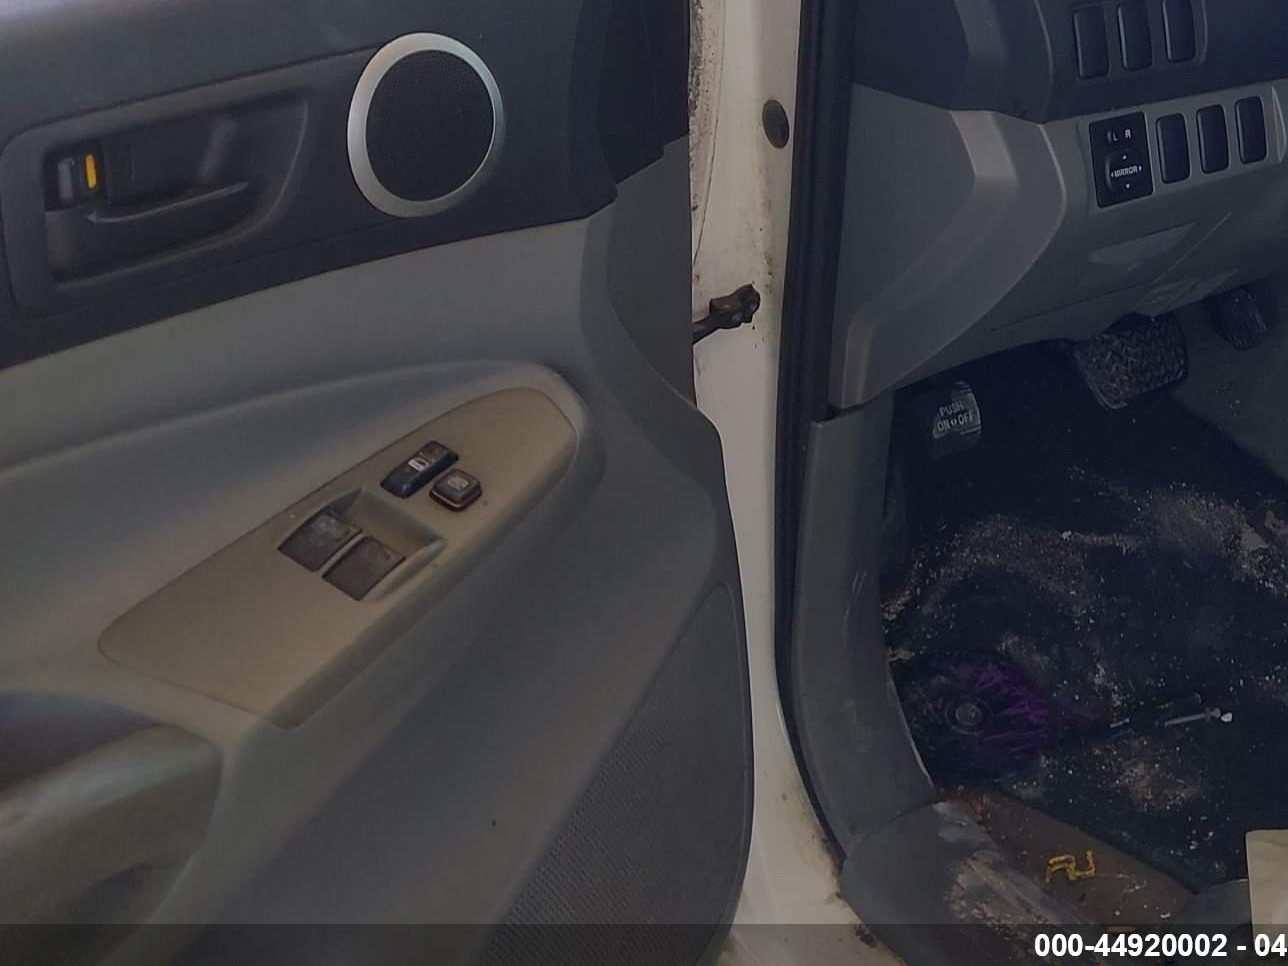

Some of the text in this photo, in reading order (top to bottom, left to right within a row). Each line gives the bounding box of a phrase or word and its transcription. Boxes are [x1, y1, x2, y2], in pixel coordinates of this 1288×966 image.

[1124, 129, 1132, 139] R
[1114, 165, 1138, 178] MIRROR
[938, 401, 964, 416] PUSH
[936, 410, 975, 432] ON OFF
